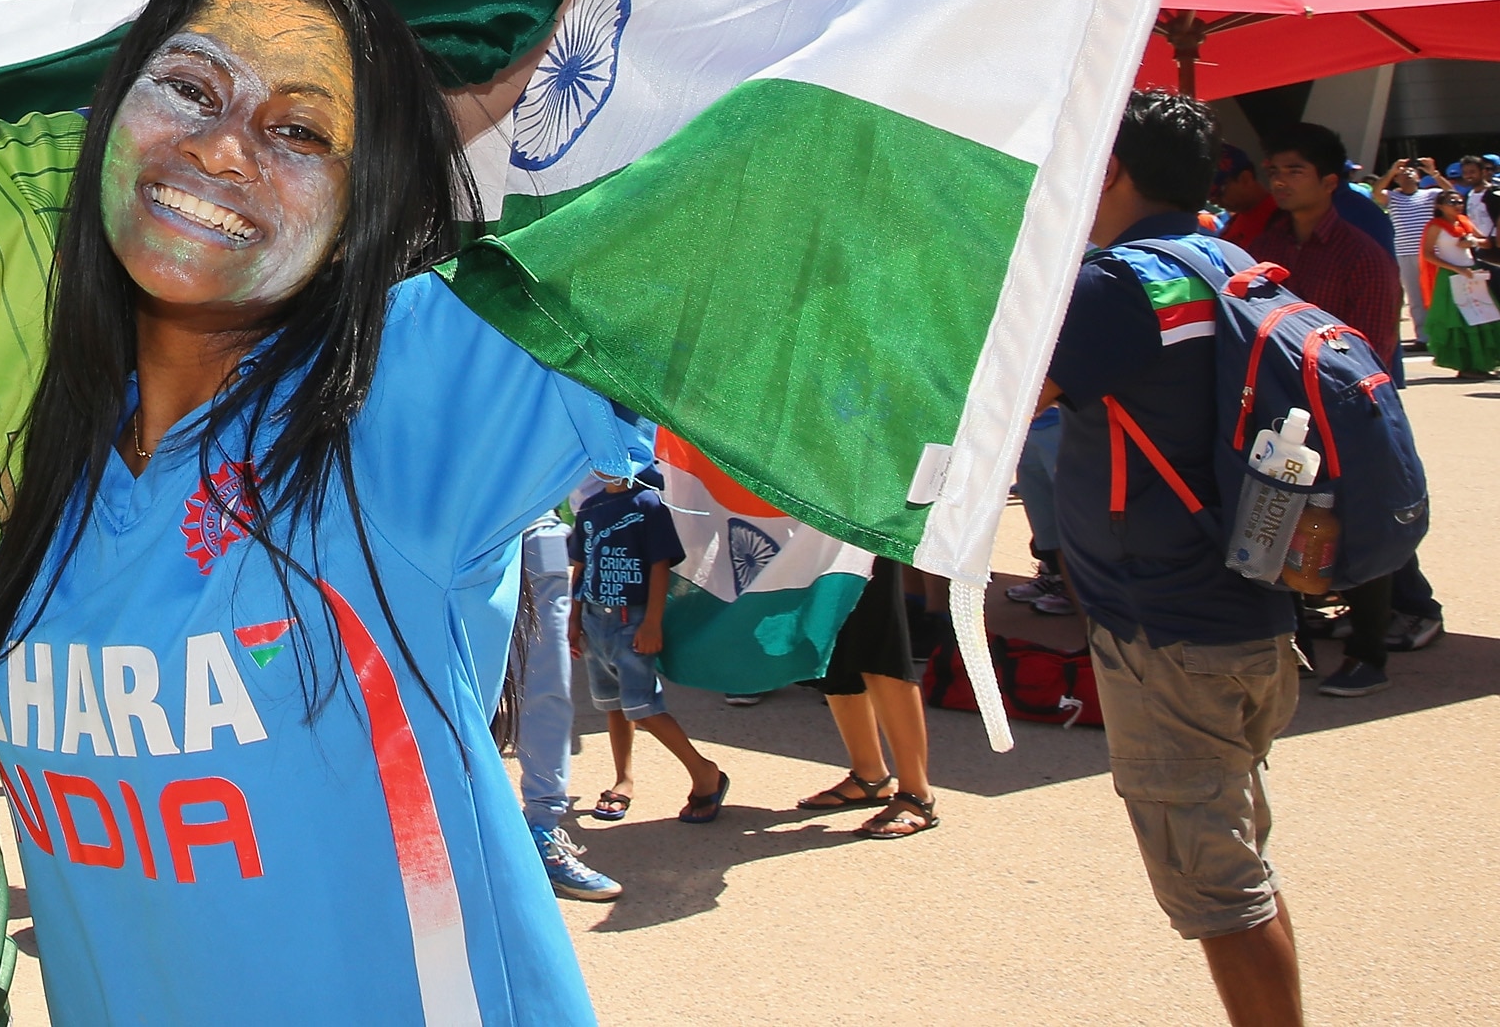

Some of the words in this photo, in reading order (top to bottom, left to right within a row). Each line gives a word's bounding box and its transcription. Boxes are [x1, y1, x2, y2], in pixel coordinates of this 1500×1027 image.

[611, 547, 628, 557] ICC
[600, 557, 641, 571] CRICKE
[600, 570, 642, 584] WORLD
[600, 583, 624, 596] CUP
[599, 596, 628, 607] 2015
